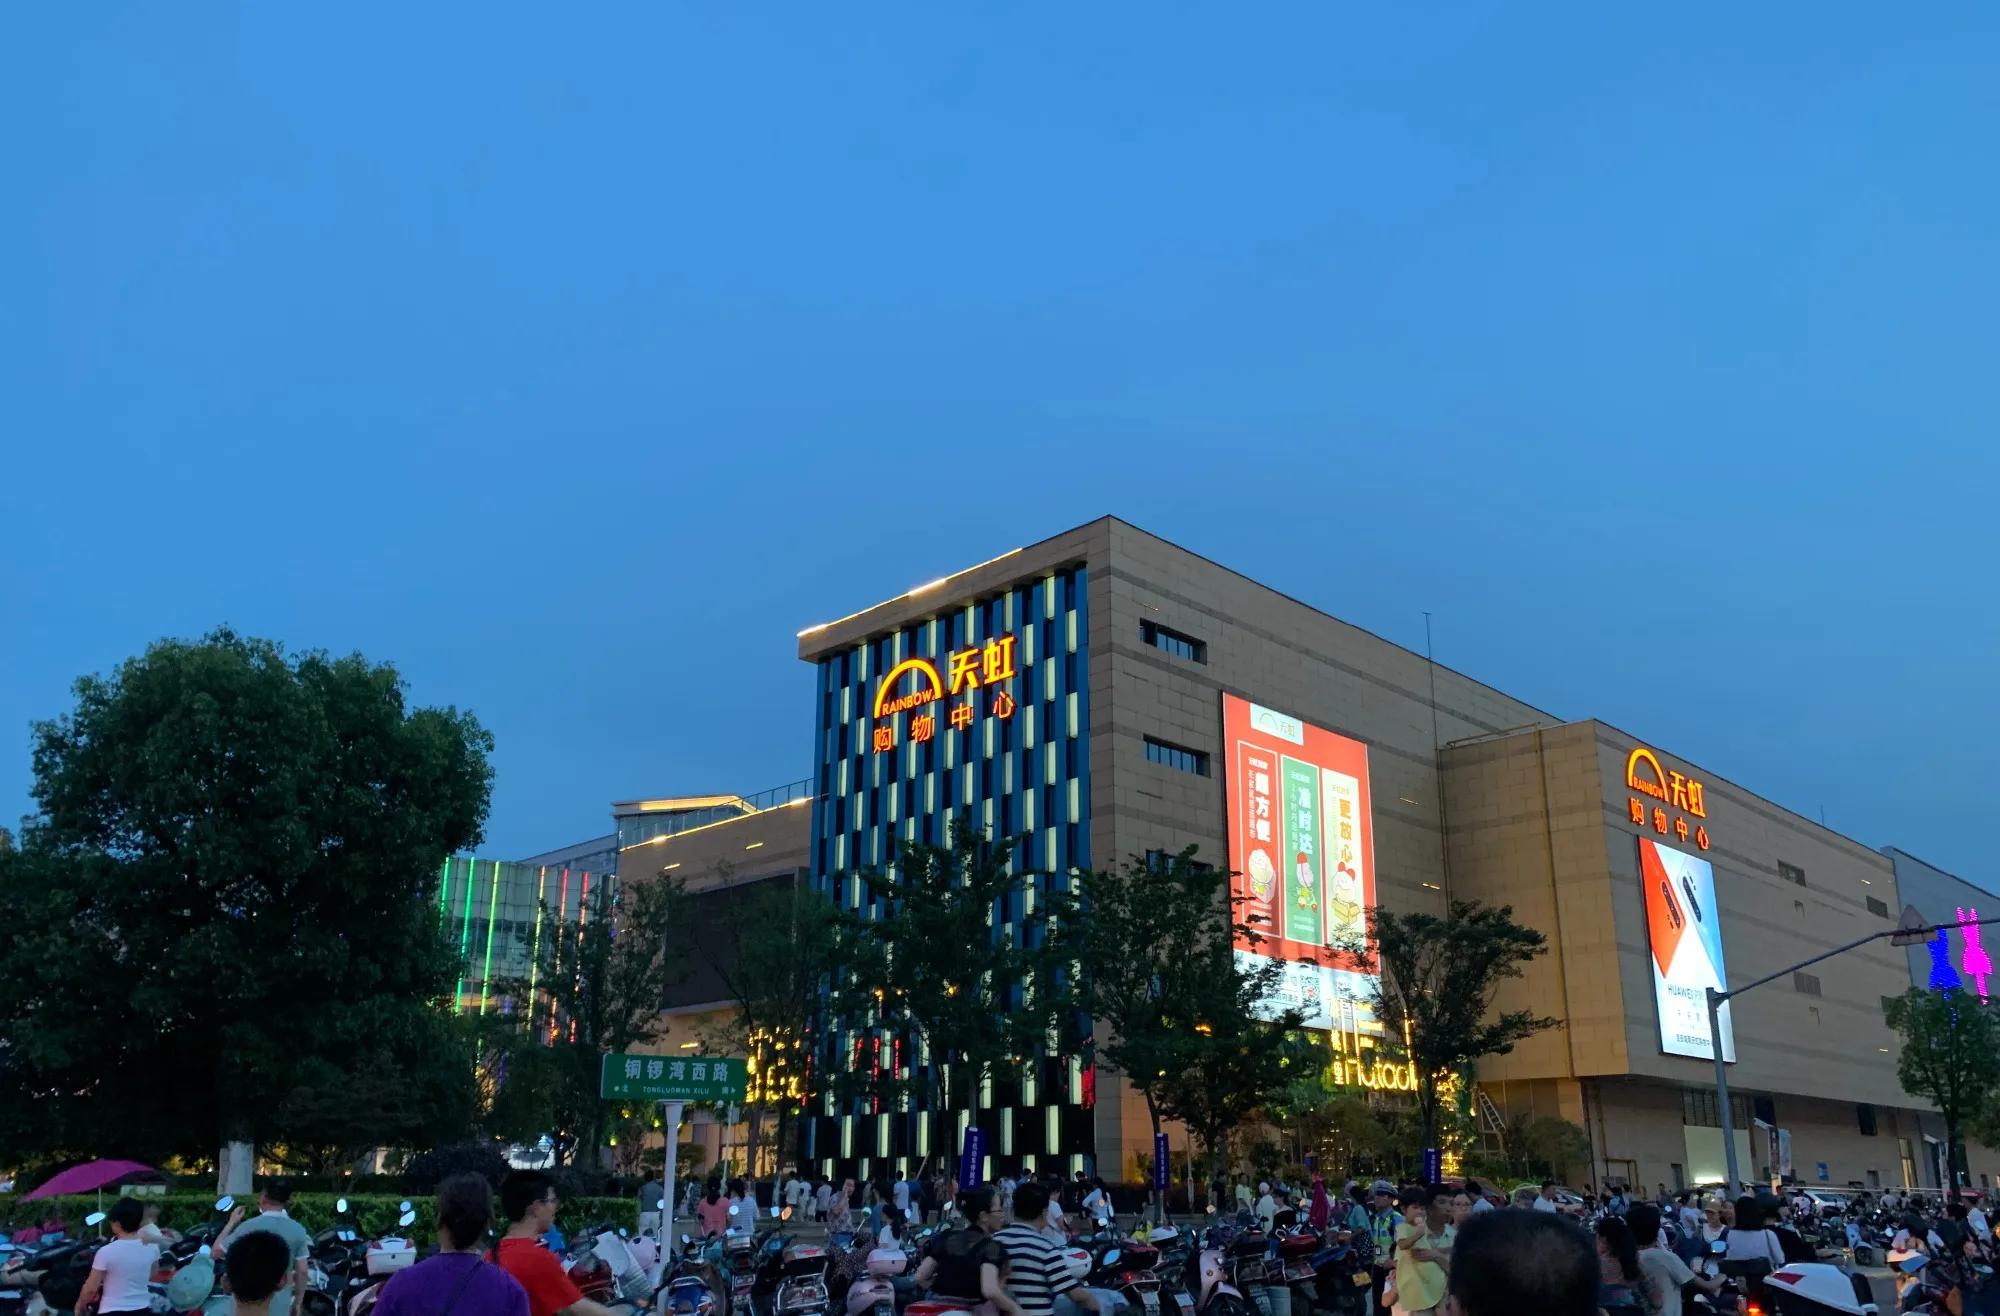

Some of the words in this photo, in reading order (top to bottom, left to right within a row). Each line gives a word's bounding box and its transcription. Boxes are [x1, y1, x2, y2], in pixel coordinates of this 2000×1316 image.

[951, 636, 1015, 695] 天虹
[873, 691, 1015, 753] 购物中心
[882, 689, 933, 716] RAINBOW
[1255, 773, 1270, 842] 方便
[1633, 776, 1664, 798] RAINBOW
[1669, 770, 1706, 818] 天虹
[1629, 797, 1709, 850] 购物中心
[1668, 984, 1694, 1000] HUAWEI
[625, 1058, 729, 1082] 铜锣湾西路
